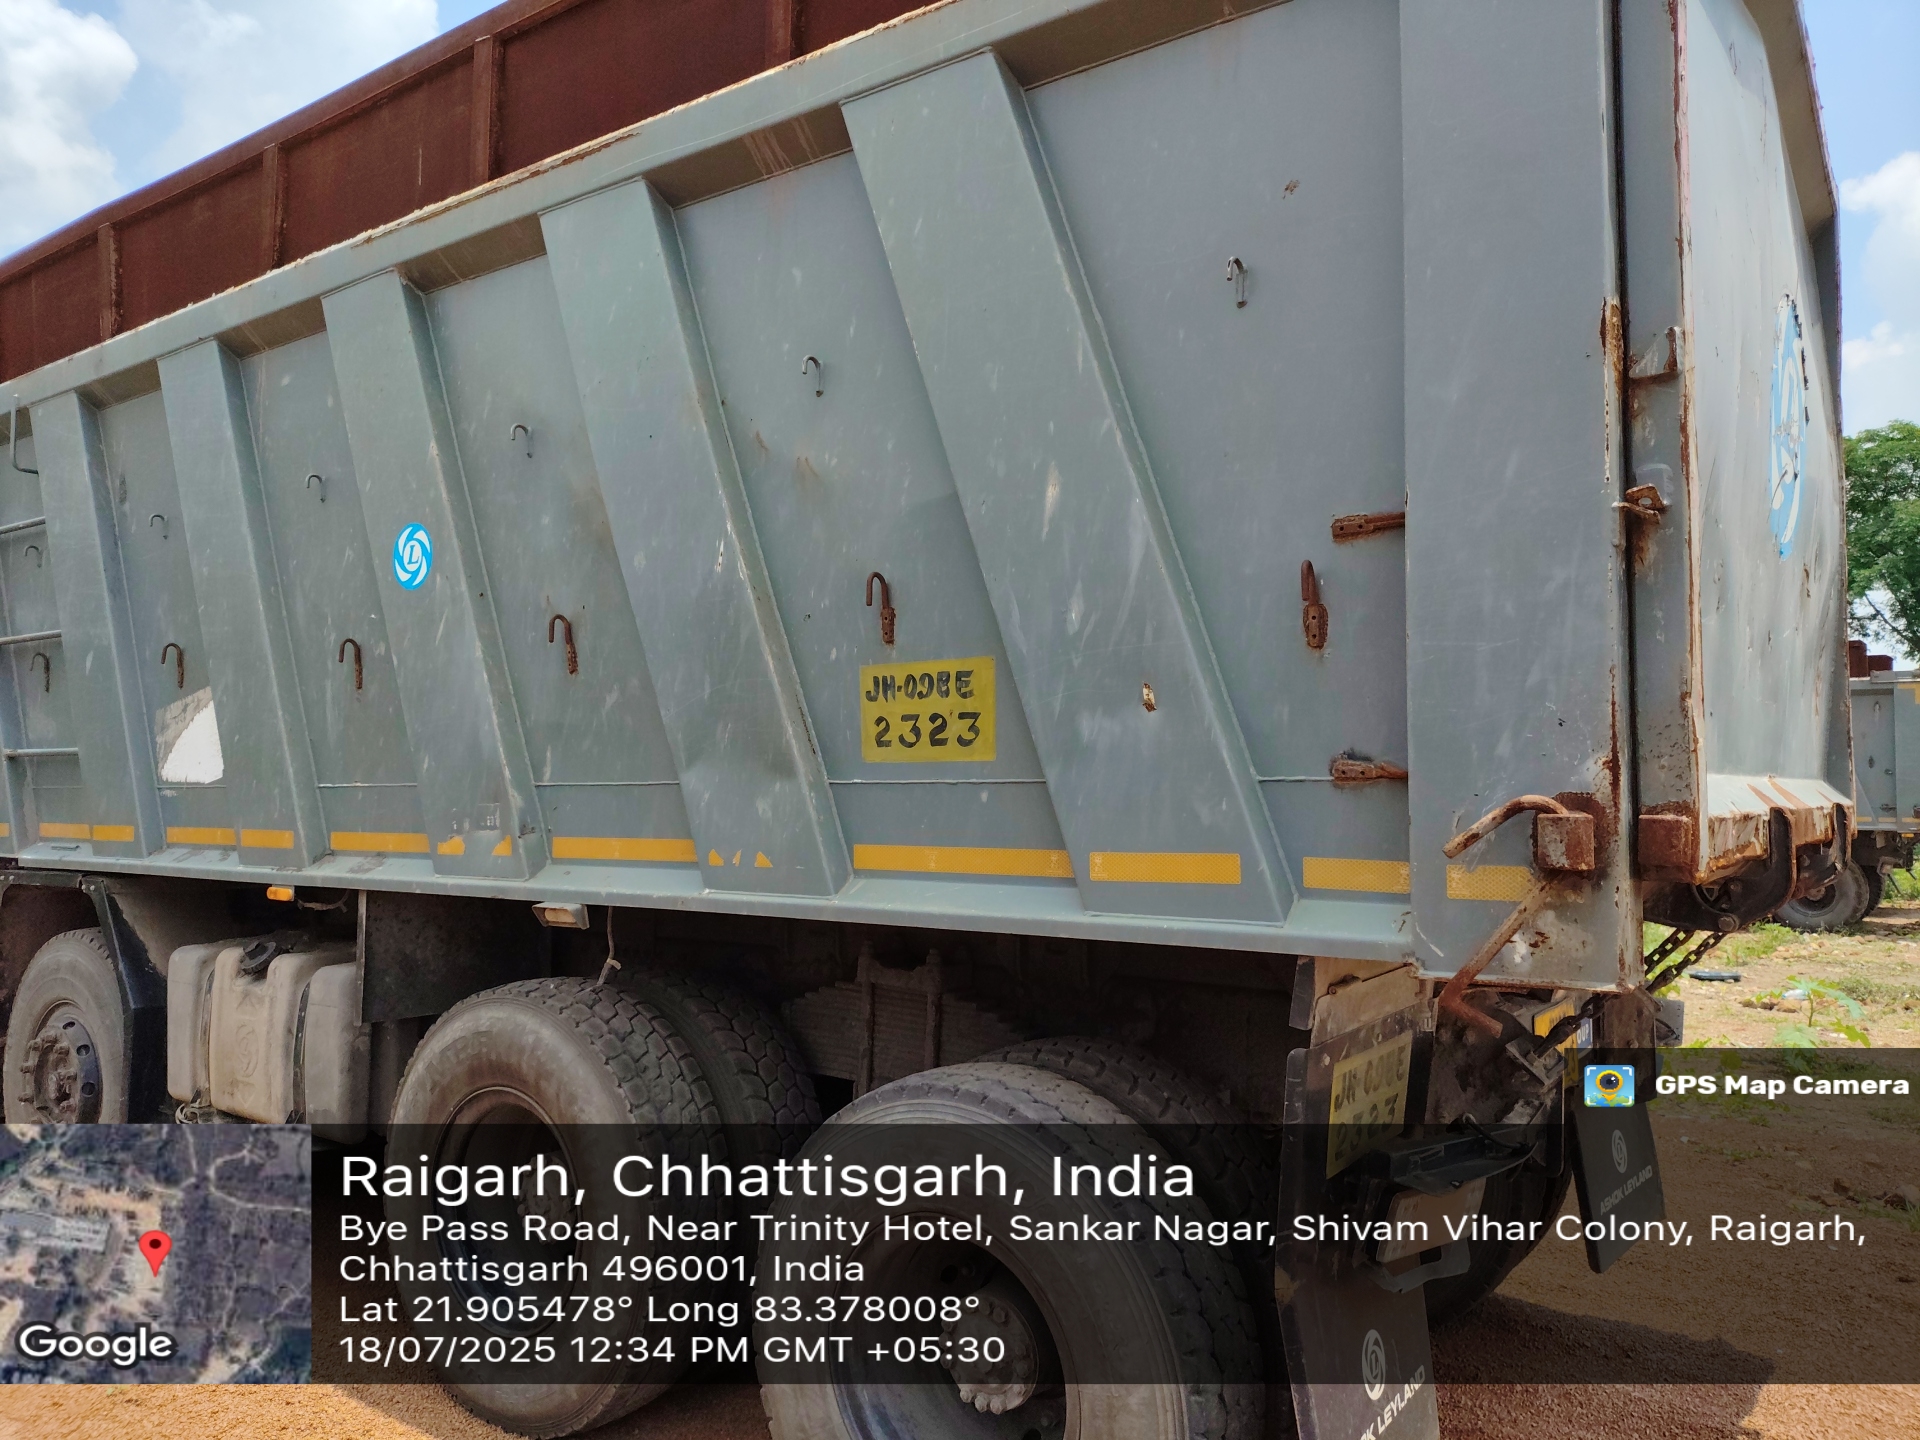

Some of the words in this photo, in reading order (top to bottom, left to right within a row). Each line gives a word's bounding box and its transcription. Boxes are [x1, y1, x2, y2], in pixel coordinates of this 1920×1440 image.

[873, 711, 981, 748] 2323
[1600, 1186, 1624, 1216] ASHOK
[1623, 1165, 1653, 1196] LEYLAND
[1377, 1365, 1426, 1435] LEYLAND
